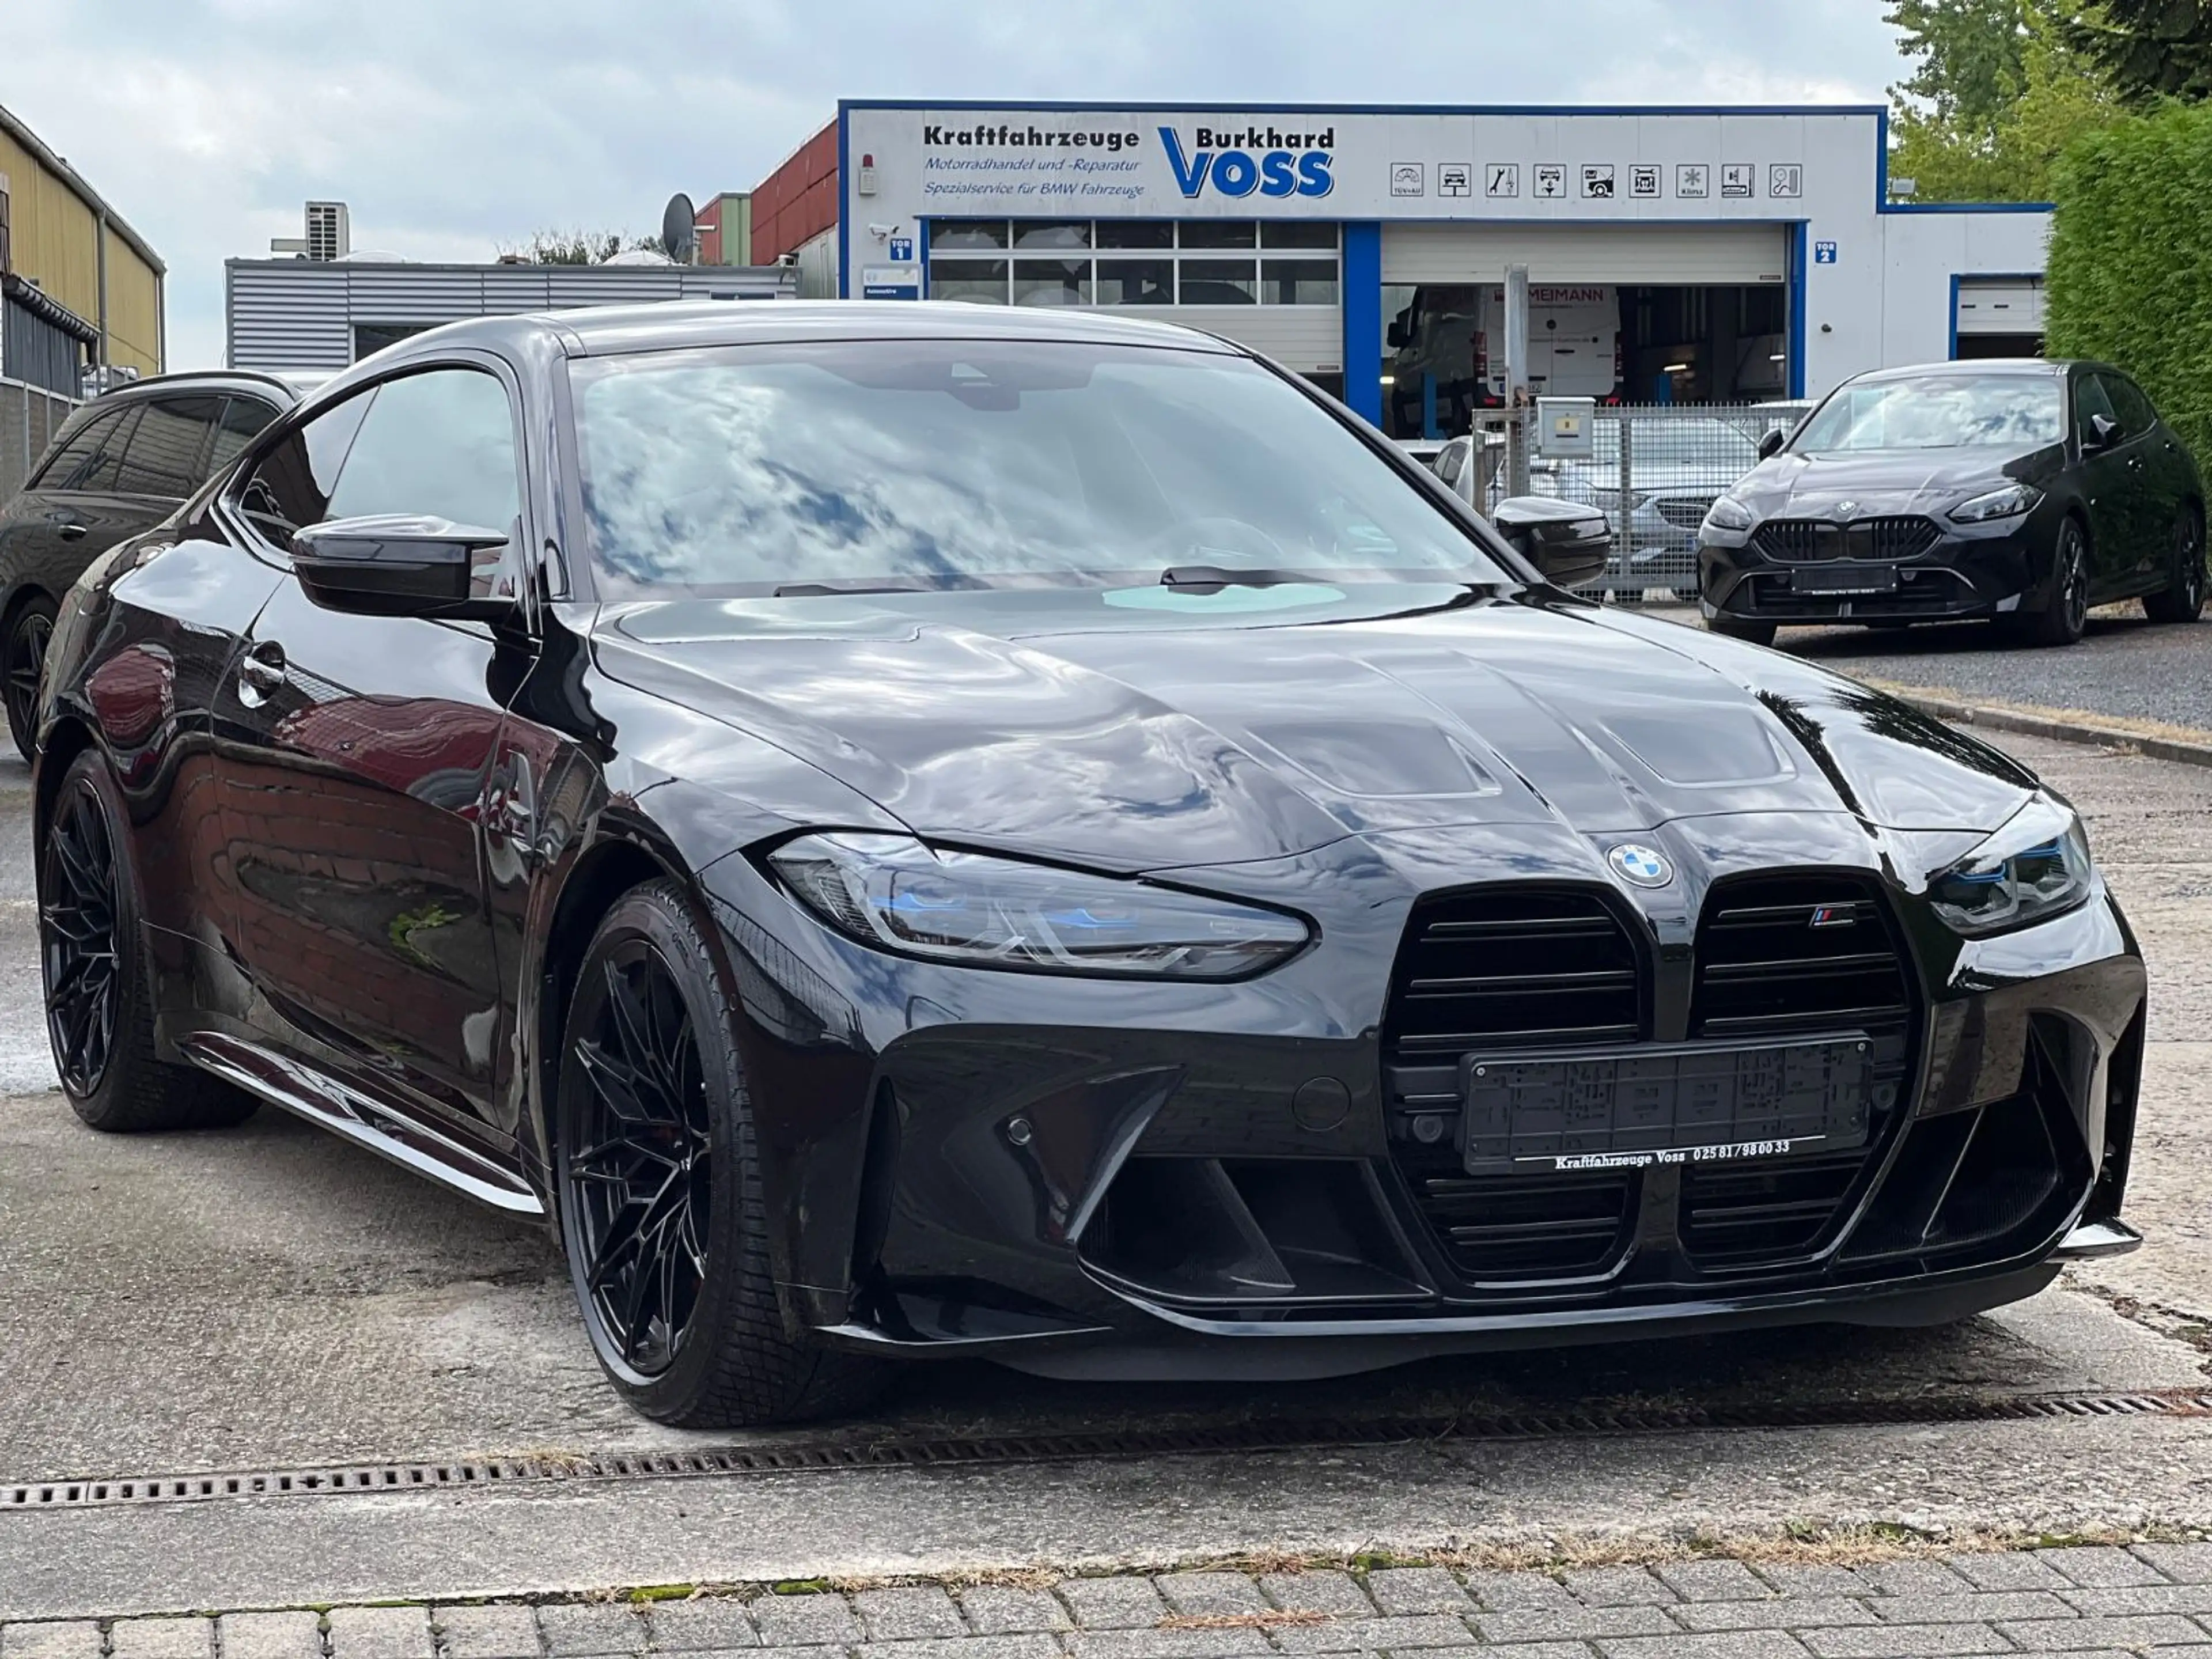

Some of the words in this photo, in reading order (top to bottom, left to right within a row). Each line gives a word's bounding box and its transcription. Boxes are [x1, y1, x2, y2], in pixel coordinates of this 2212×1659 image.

[924, 126, 1140, 151] Kraftfahrzeuge
[1196, 127, 1334, 147] Burkhard
[925, 158, 1035, 171] Motorradhandel
[1038, 158, 1066, 171] und
[1068, 158, 1141, 173] -Reparatur
[925, 182, 1013, 196] Spezialservice
[1017, 183, 1036, 195] für
[1040, 183, 1078, 194] BMW
[1081, 183, 1145, 199] Fahrzeuge
[897, 248, 903, 259] 1
[1820, 252, 1830, 262] 2
[1555, 1155, 1652, 1169] Kraftfahrzeuge
[1656, 1152, 1685, 1163] Voss
